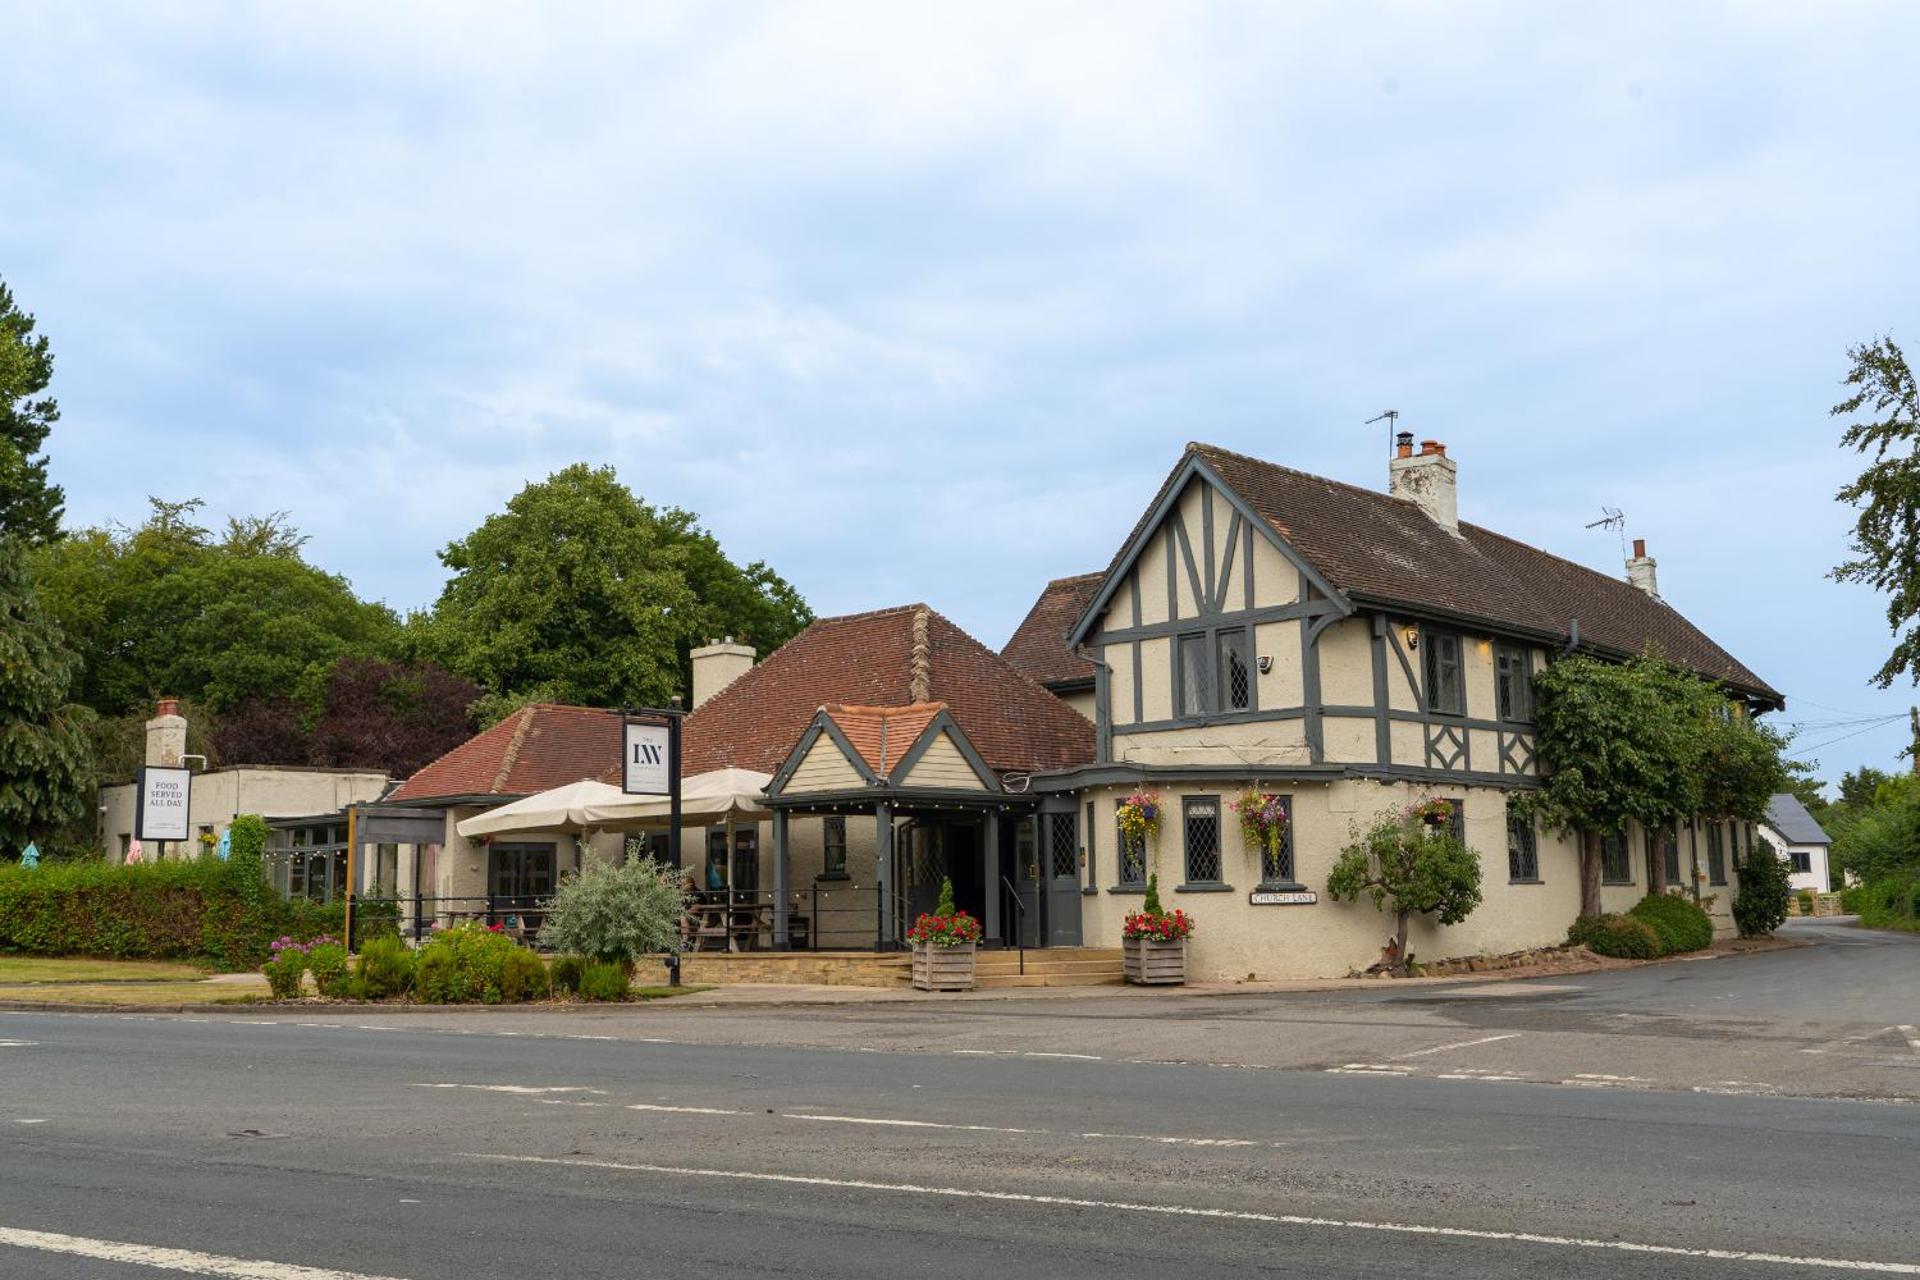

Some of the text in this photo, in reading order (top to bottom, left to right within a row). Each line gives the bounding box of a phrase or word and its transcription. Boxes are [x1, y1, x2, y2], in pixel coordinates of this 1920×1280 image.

[155, 782, 179, 790] FOOD
[151, 790, 183, 799] SERVED
[150, 799, 183, 807] ALL DAY
[1254, 894, 1312, 902] CHURCH LANE
